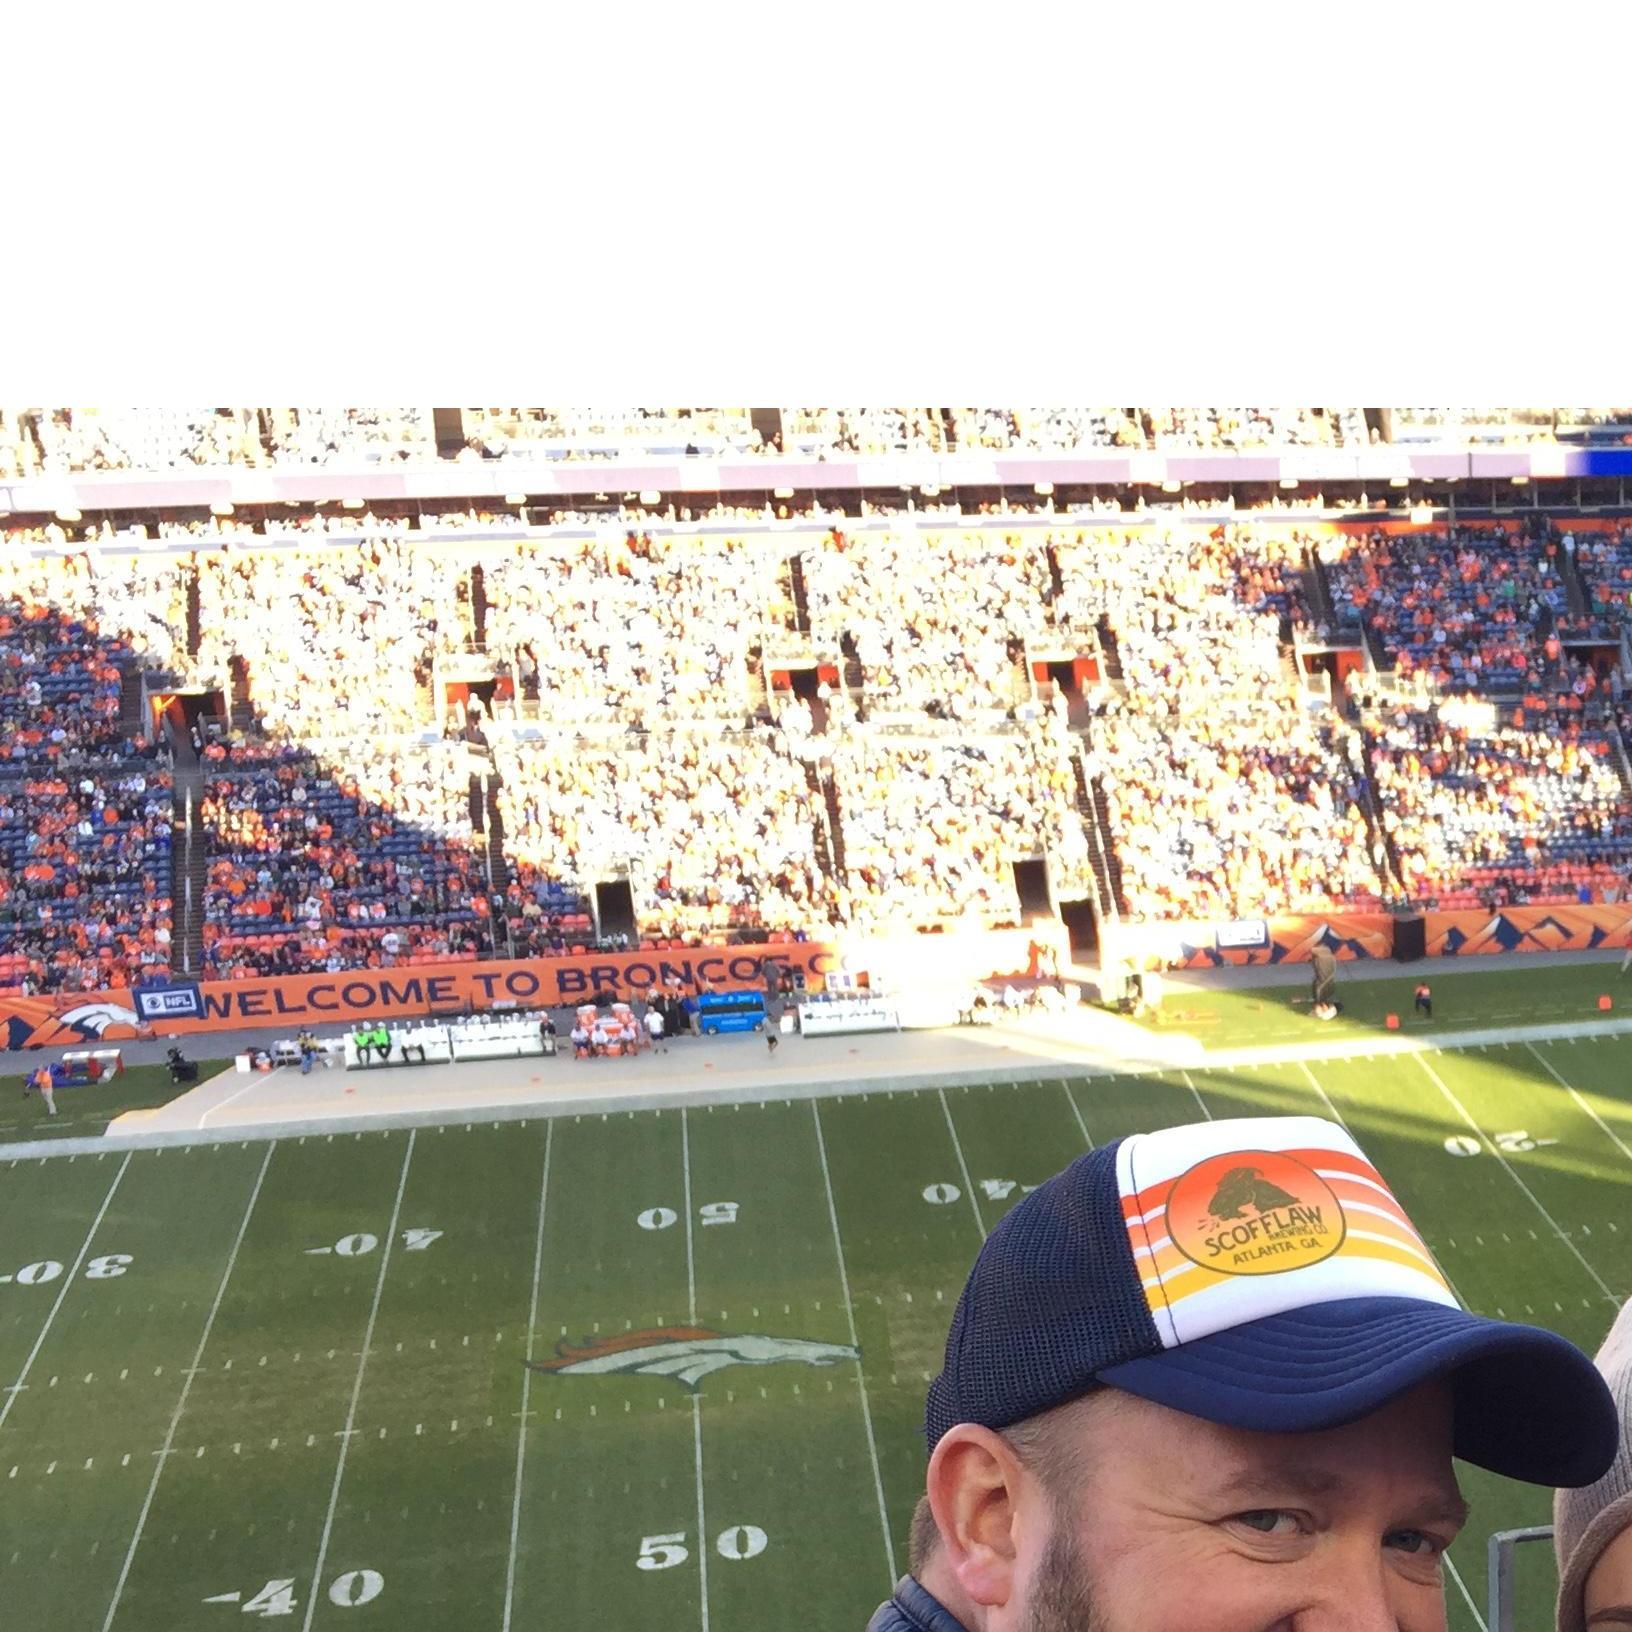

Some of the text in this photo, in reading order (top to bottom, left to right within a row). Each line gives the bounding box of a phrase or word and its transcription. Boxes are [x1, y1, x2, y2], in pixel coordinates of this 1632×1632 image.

[201, 976, 459, 1020] WELCOME
[473, 970, 541, 999] TO
[1204, 1205, 1323, 1258] SCOFFLAW
[1232, 1240, 1297, 1266] ATLANTA
[636, 1525, 768, 1571] 50
[241, 1569, 384, 1618] 40
